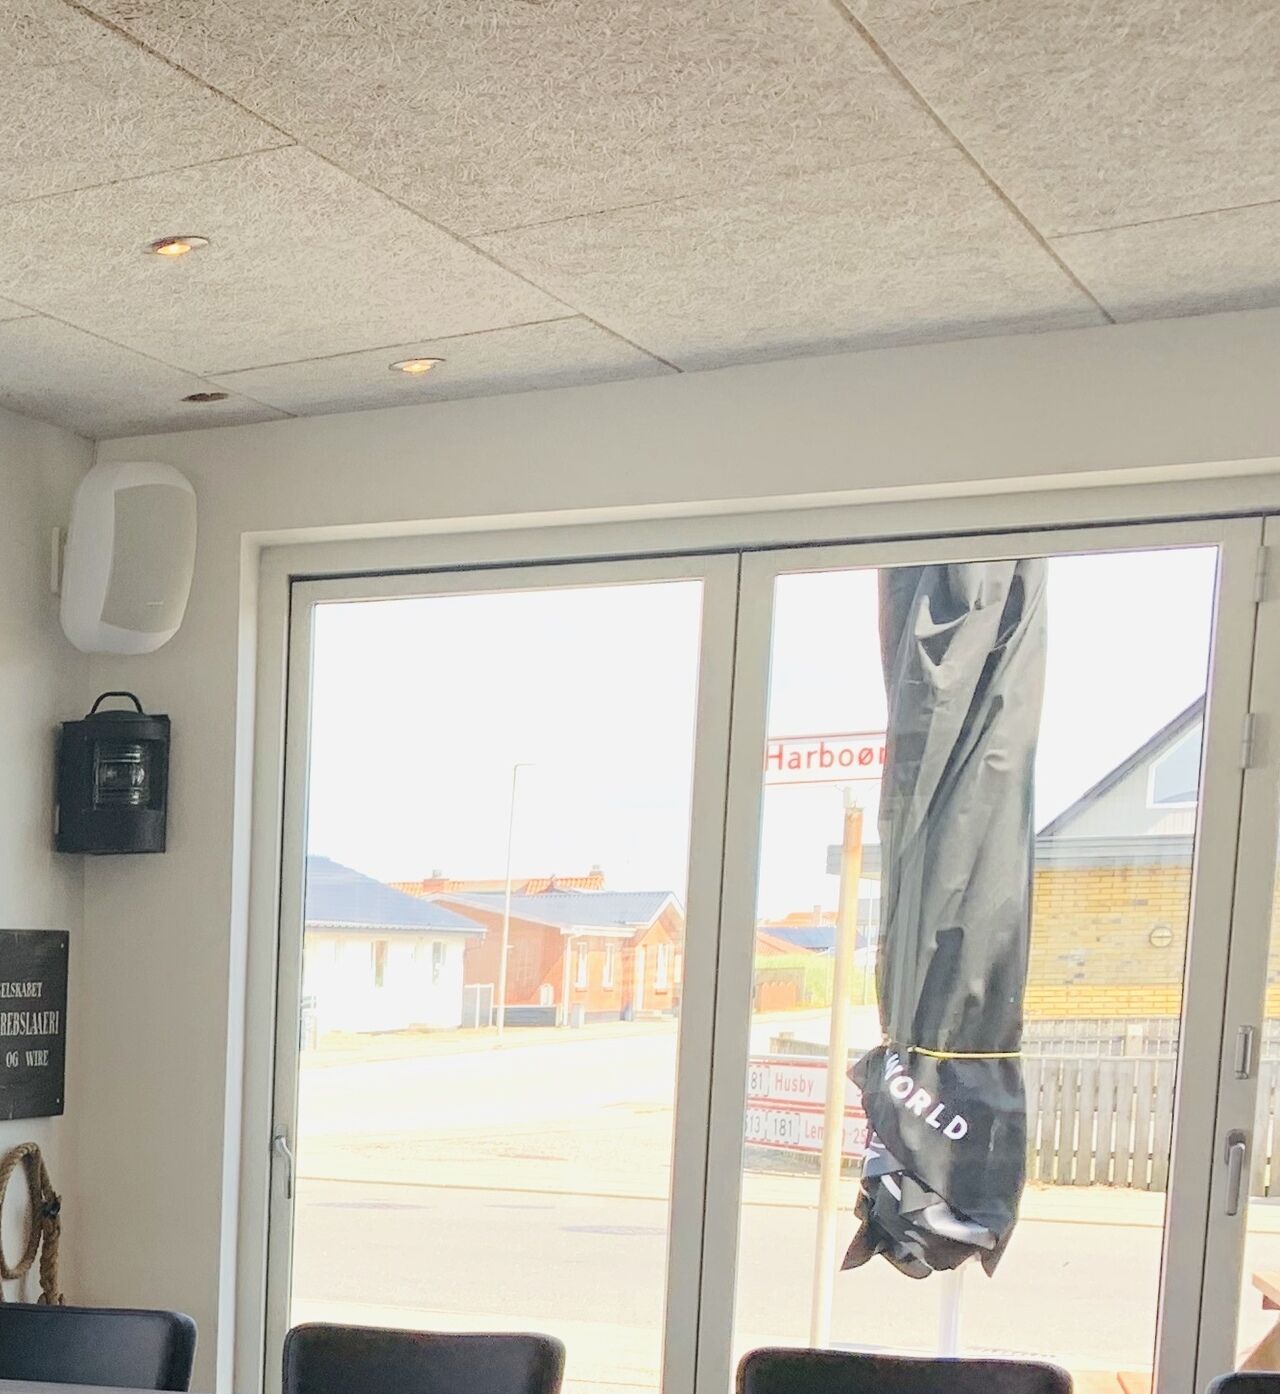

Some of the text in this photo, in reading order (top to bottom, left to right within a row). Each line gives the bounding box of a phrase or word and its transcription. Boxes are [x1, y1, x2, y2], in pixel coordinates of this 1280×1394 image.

[5, 1050, 19, 1069] OG
[25, 1048, 50, 1067] WIRE
[774, 1071, 814, 1098] Husby
[883, 1047, 969, 1140] WORLD
[774, 1117, 792, 1137] 181
